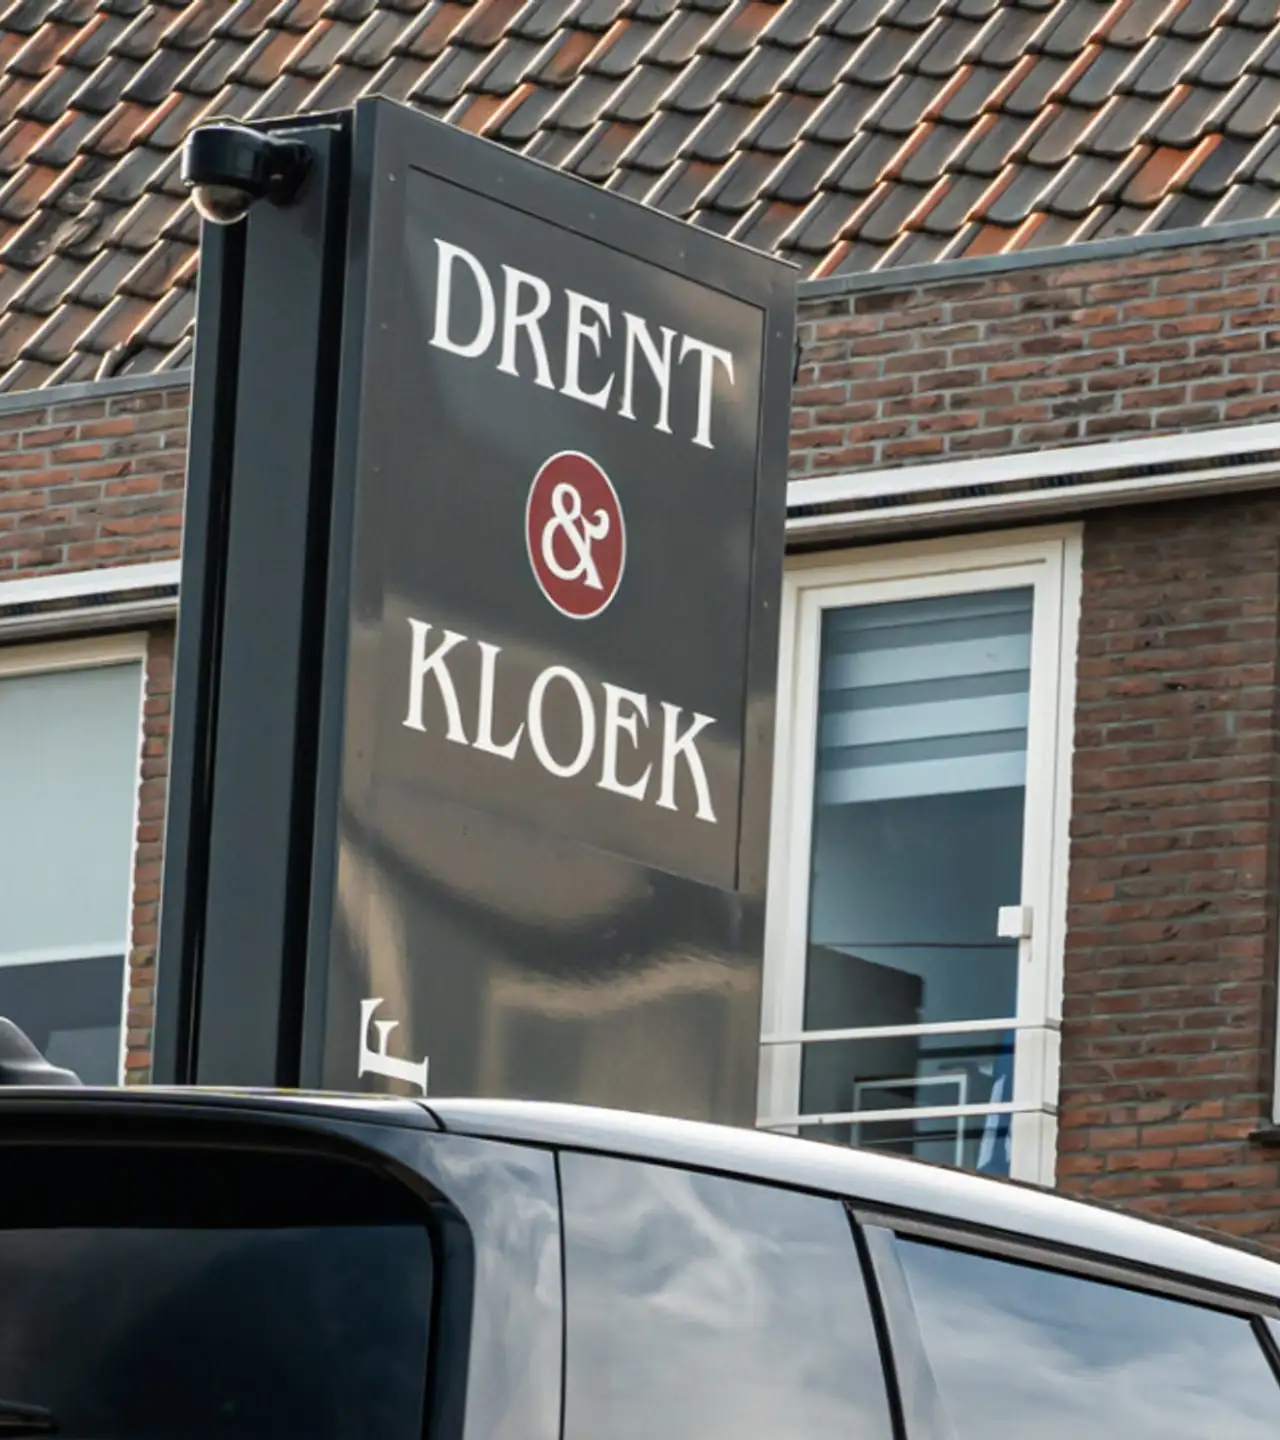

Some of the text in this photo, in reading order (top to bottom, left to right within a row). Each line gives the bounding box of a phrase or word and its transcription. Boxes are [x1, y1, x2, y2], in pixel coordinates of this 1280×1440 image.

[429, 236, 735, 451] DRENT
[541, 482, 610, 591] &
[402, 617, 718, 824] KLOEK
